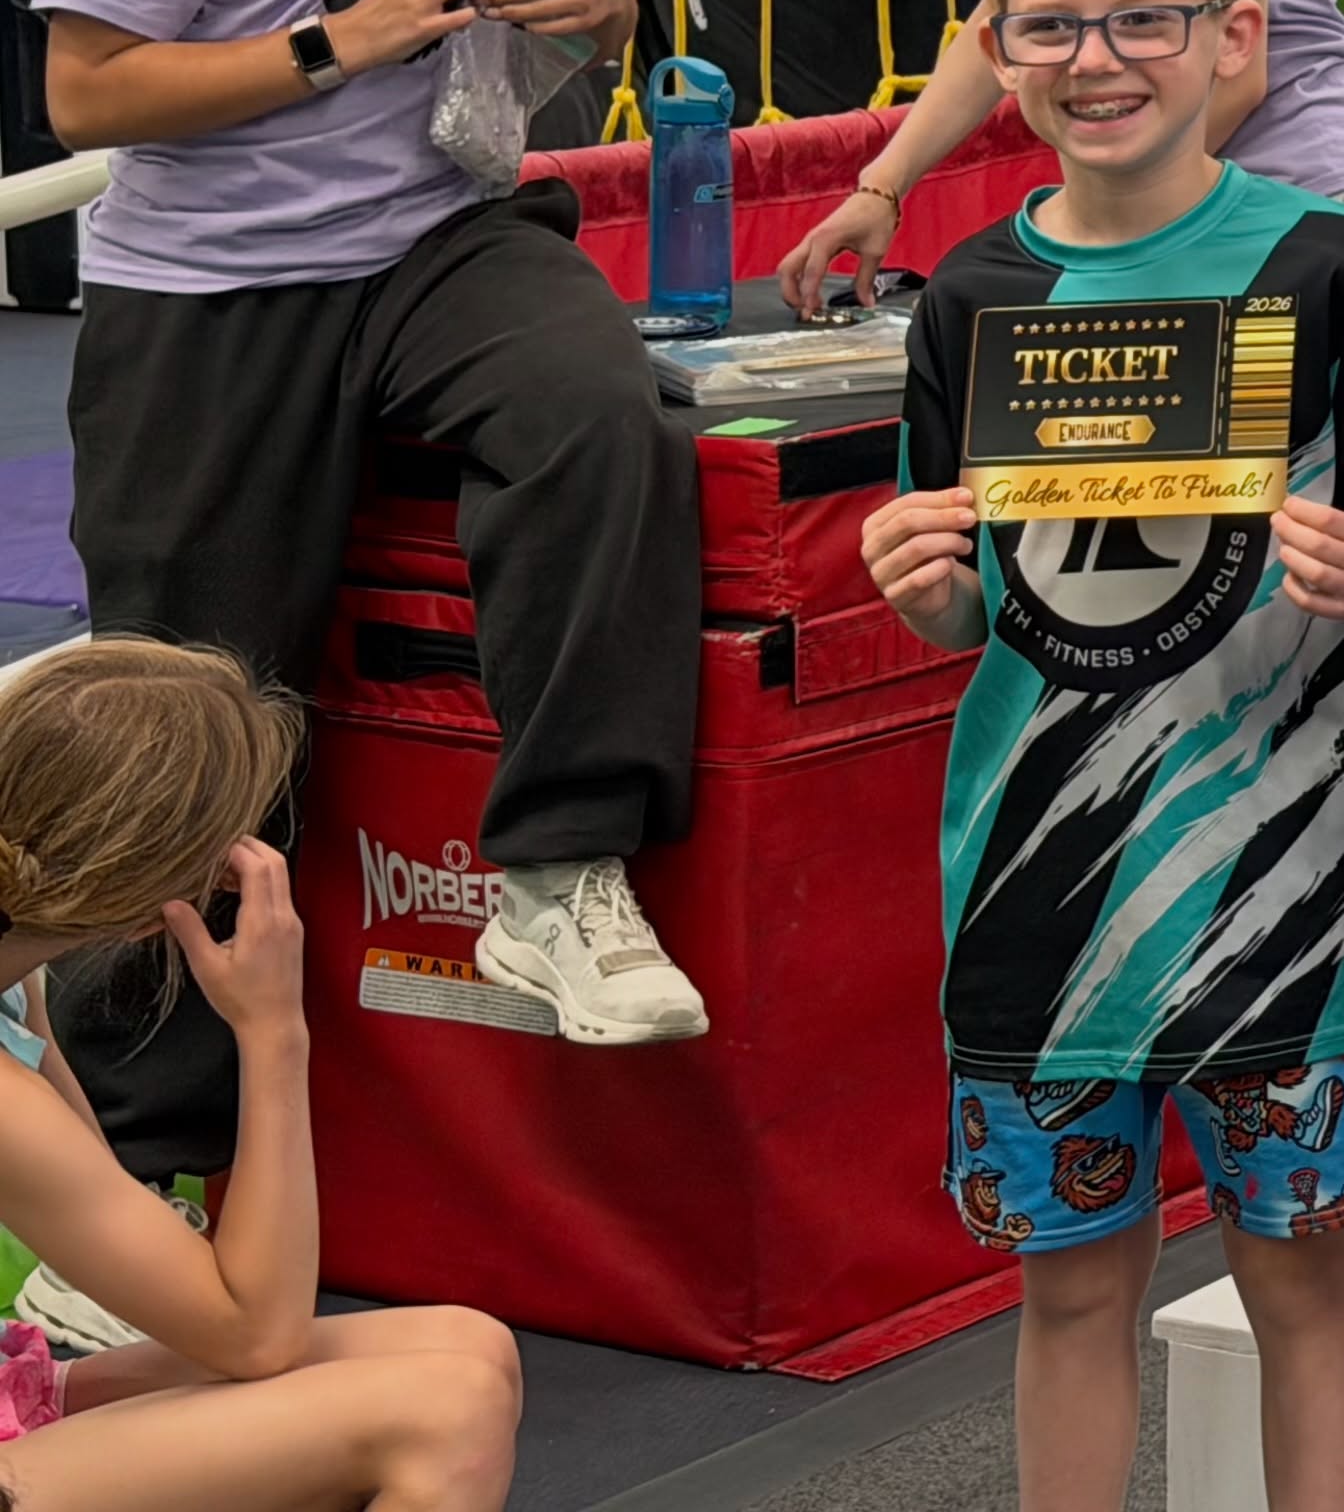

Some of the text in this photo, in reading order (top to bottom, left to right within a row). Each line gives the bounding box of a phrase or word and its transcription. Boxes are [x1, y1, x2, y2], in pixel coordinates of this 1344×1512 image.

[1244, 296, 1293, 312] 2026
[1014, 345, 1178, 384] TICKET
[1059, 420, 1131, 442] ENDURANCE
[984, 471, 1273, 517] Golden Ticket To Finals!
[1043, 634, 1135, 668] FITNESS
[1155, 530, 1248, 651] OBSTACLES
[358, 826, 506, 930] NORBER
[406, 955, 484, 982] WARN
